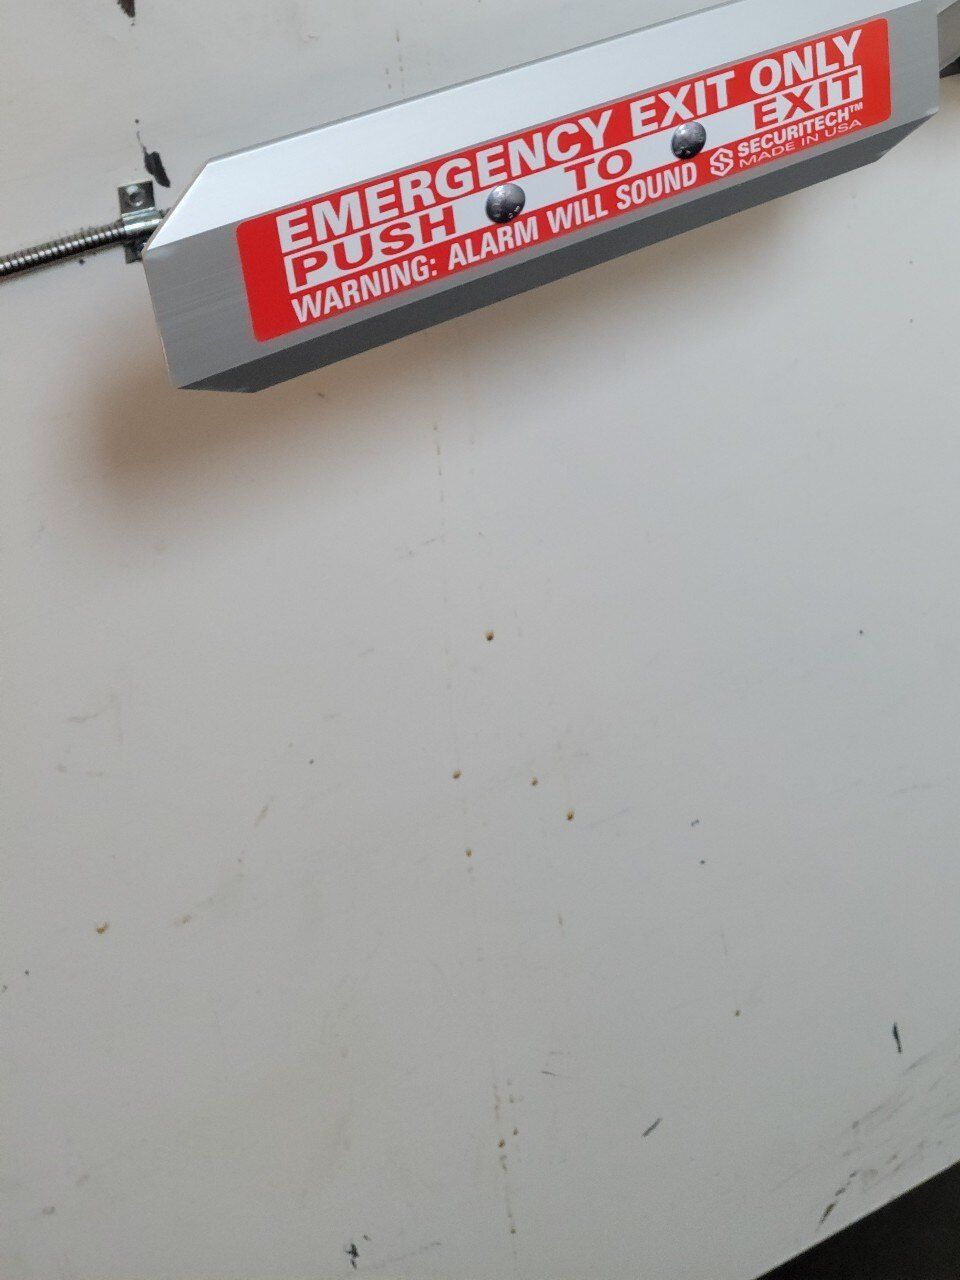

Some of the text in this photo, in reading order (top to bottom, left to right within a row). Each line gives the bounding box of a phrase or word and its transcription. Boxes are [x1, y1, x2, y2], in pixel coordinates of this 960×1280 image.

[275, 29, 862, 253] EMERGENCY EXIT ONLY
[293, 70, 859, 288] PUSH TO EXIT
[739, 119, 862, 168] MADE IN USA
[291, 161, 698, 323] WARNING: ALARM WILL SOUND
